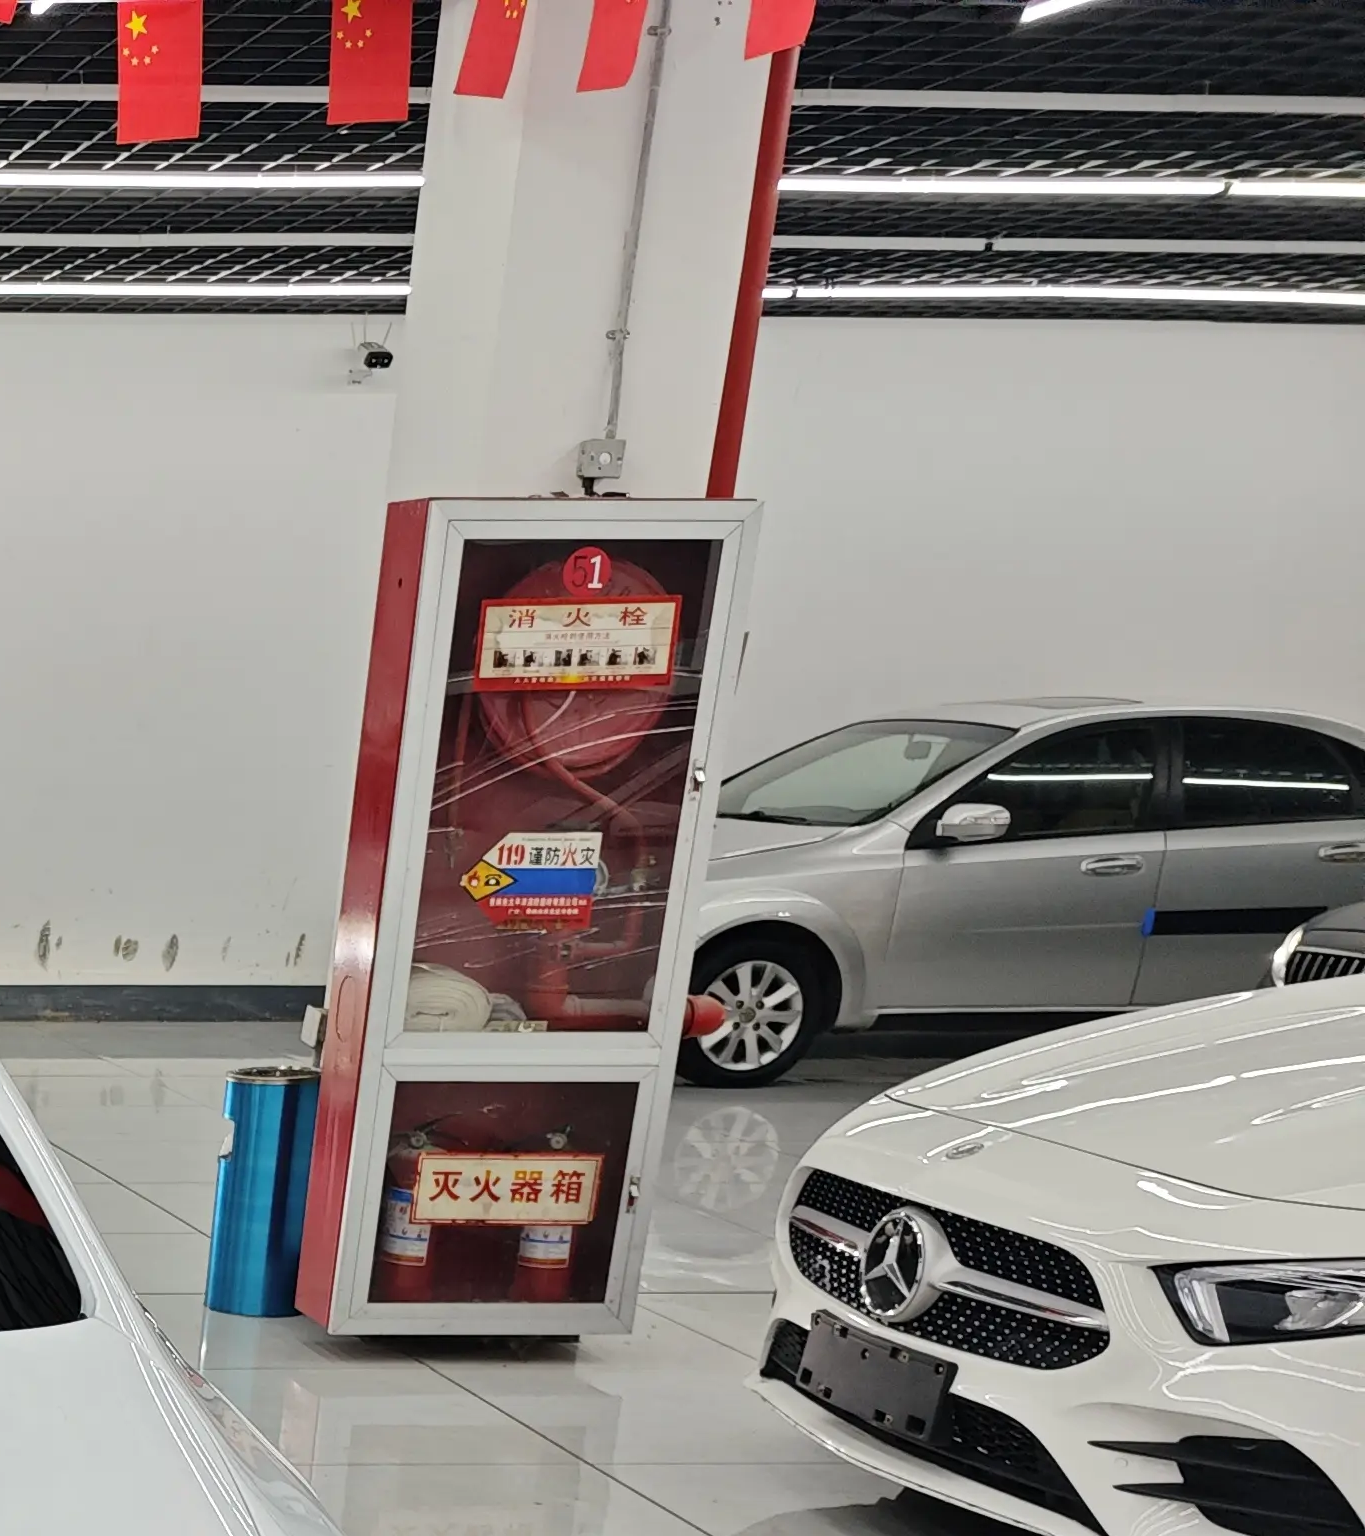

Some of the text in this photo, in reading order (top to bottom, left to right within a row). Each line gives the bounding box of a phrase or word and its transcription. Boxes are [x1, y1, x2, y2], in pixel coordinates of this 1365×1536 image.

[508, 606, 648, 629] 消火栓
[497, 843, 595, 866] 119 谨防火灾
[429, 1169, 586, 1204] 灭火器箱
